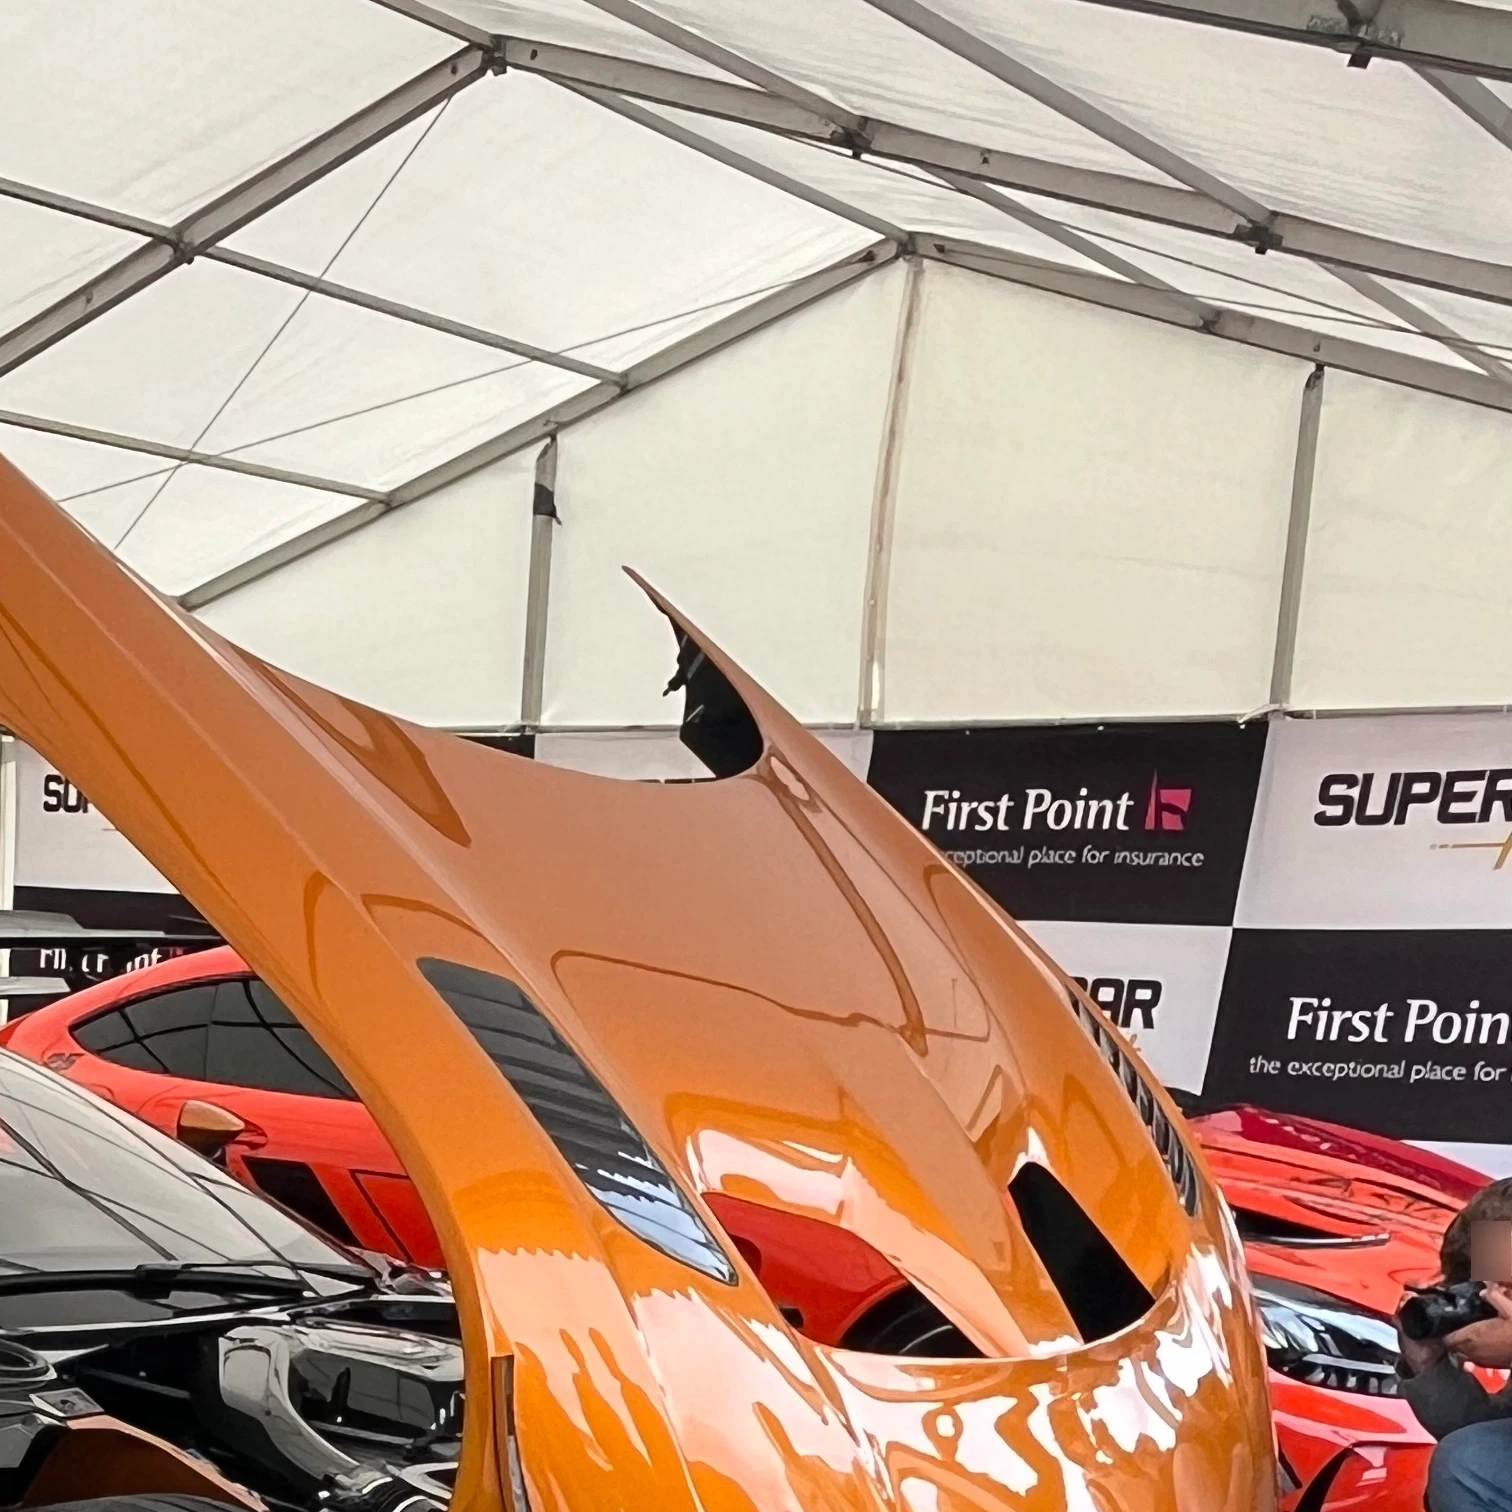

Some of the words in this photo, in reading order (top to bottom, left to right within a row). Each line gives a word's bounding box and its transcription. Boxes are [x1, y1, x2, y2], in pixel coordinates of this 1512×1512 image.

[921, 789, 1015, 831] First
[1022, 787, 1135, 831] Point
[1313, 768, 1512, 827] SUPER
[1027, 845, 1077, 869] place
[1082, 844, 1110, 864] for
[1113, 845, 1205, 867] insurance
[1287, 996, 1395, 1043] First
[1403, 998, 1512, 1045] Poin
[1249, 1055, 1282, 1075] the
[1287, 1059, 1406, 1082] exceptional
[1409, 1060, 1467, 1084] place
[1473, 1060, 1508, 1081] for
